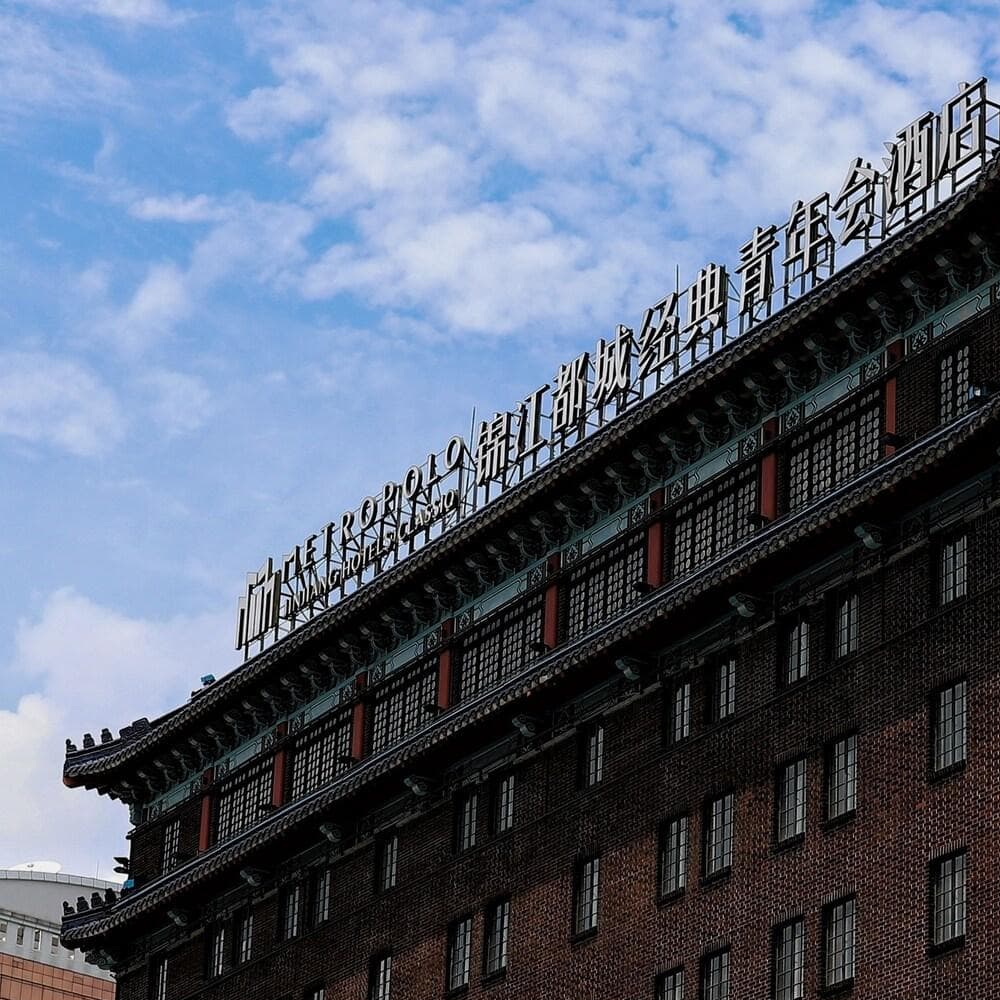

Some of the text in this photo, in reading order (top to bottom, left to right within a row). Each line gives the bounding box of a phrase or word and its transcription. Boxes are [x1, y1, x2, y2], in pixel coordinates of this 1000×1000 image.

[476, 77, 987, 487] 锦江都城经典青年会酒店
[282, 436, 464, 583] METROPOLO
